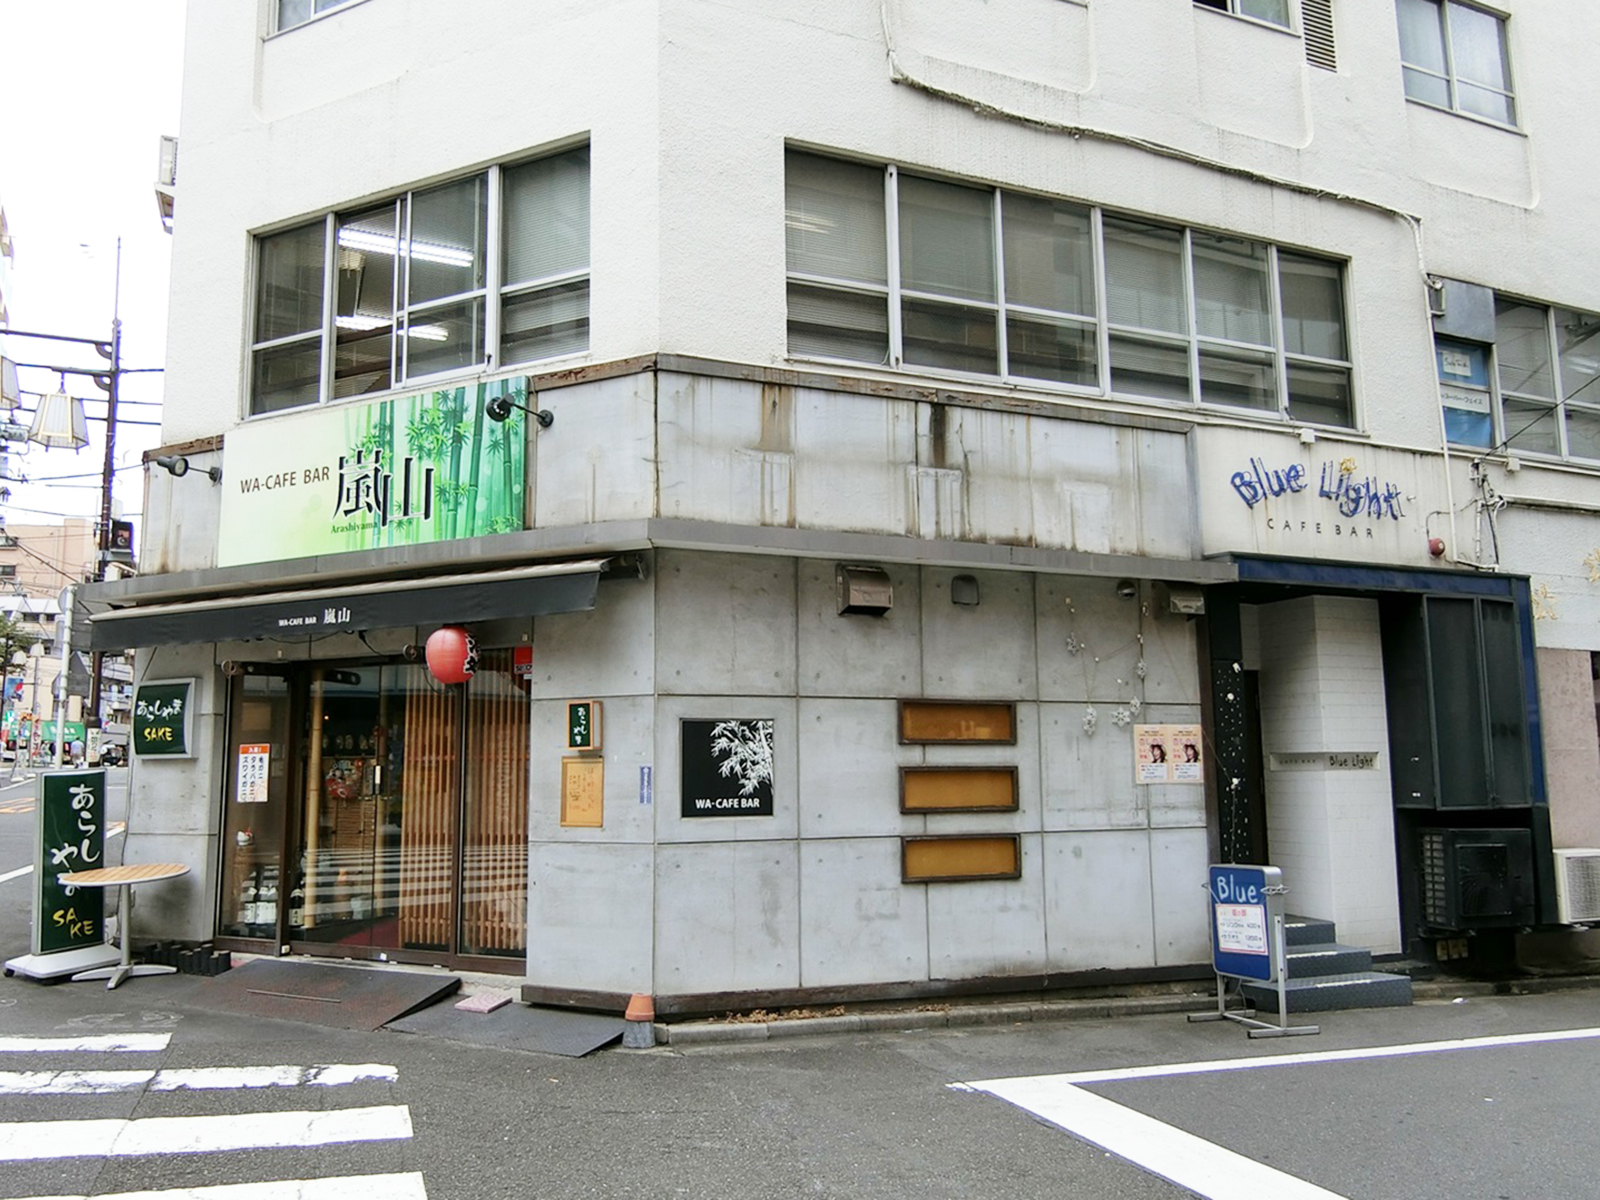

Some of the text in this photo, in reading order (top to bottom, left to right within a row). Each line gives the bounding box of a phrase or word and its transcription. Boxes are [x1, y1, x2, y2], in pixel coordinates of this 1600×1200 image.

[240, 466, 330, 494] WA-CAFE BAR
[332, 449, 435, 527] 嵐山
[1230, 456, 1406, 521] Blue Light
[331, 519, 378, 534] Arashiyama
[1266, 517, 1373, 539] CAFE BAR
[278, 616, 317, 627] WA-CAFE BAR
[323, 607, 351, 624] 嵐山
[136, 698, 183, 722] あらしやま
[143, 726, 174, 742] SAKE
[1328, 755, 1348, 767] Blue
[1351, 754, 1374, 769] Light
[740, 798, 760, 808] BAR
[1217, 873, 1258, 903] Blue
